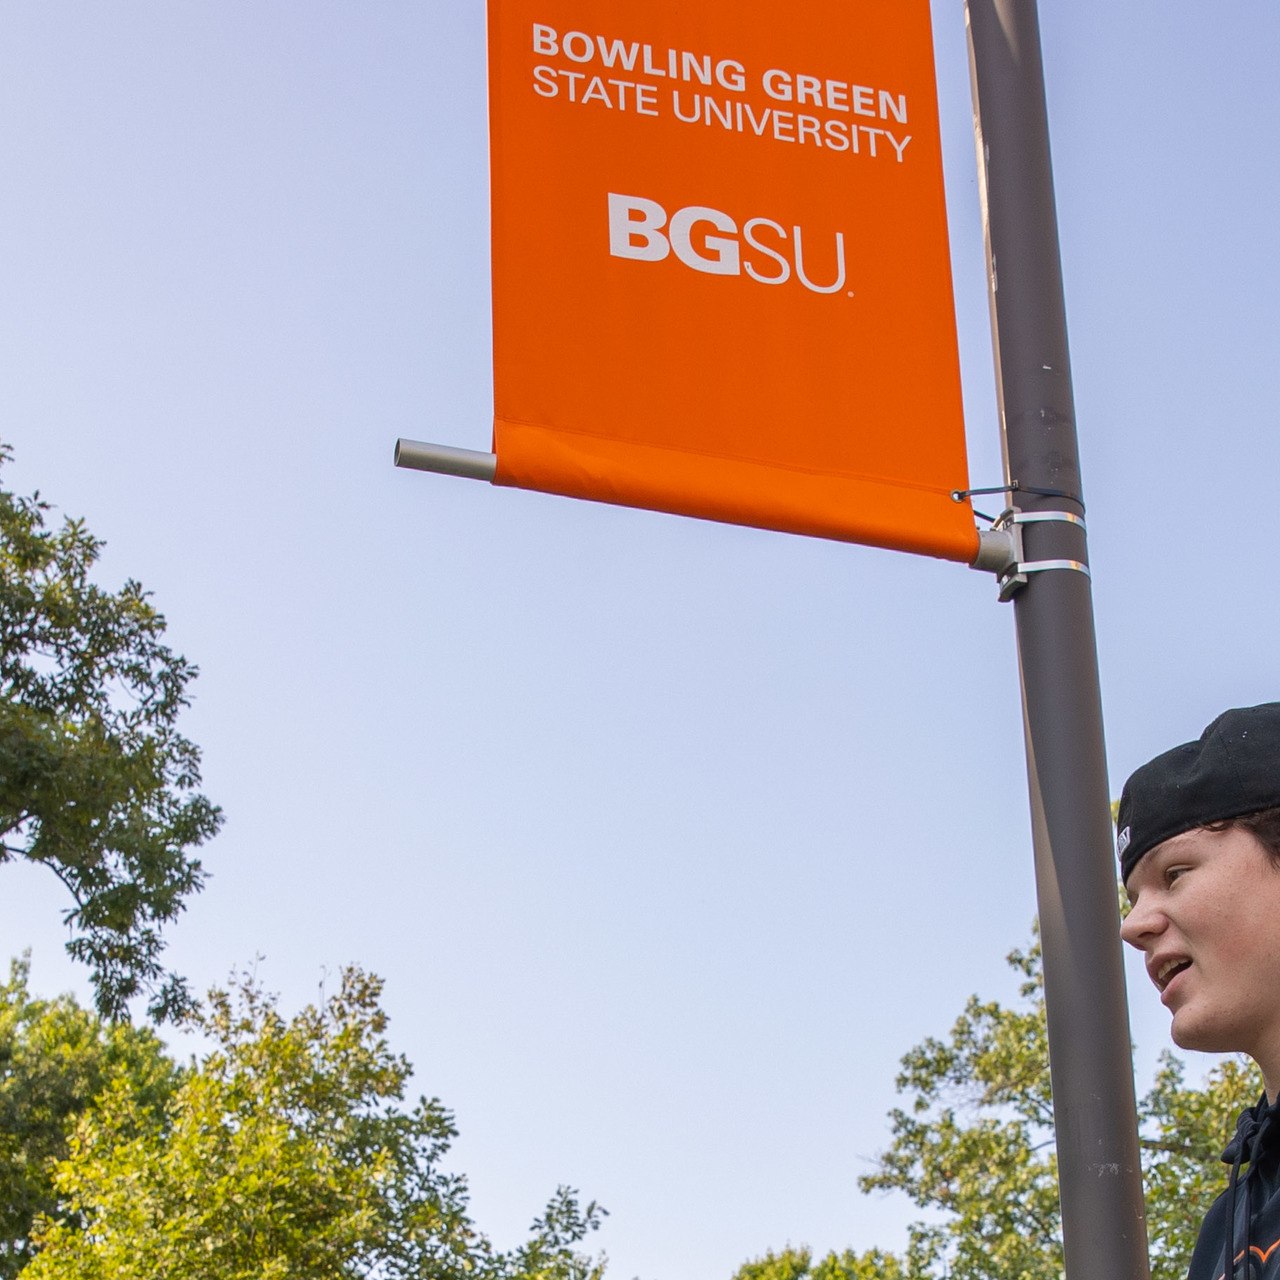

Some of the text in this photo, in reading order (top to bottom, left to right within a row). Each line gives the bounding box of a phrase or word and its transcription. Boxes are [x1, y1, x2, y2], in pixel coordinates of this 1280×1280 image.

[532, 22, 908, 125] BOWLING GREEN
[532, 65, 913, 163] STATE UNIVERSITY
[607, 191, 847, 295] BGSU
